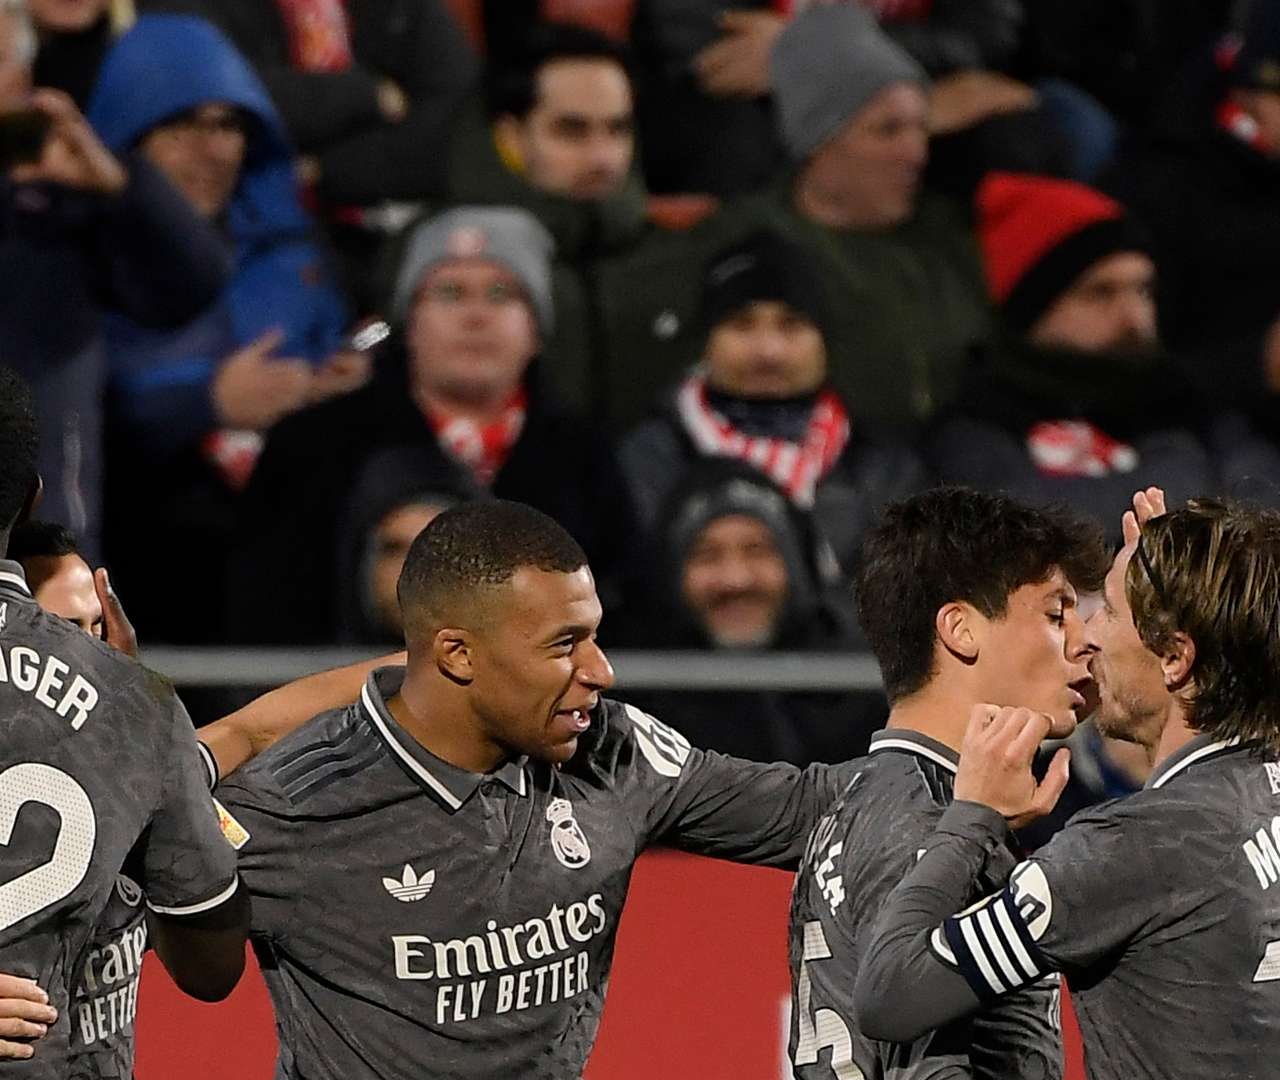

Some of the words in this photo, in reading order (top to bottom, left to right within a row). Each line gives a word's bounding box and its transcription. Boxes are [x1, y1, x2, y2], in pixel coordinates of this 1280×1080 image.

[391, 893, 606, 980] Emirates
[436, 980, 487, 1025] FLY
[496, 951, 590, 1014] BETTER
